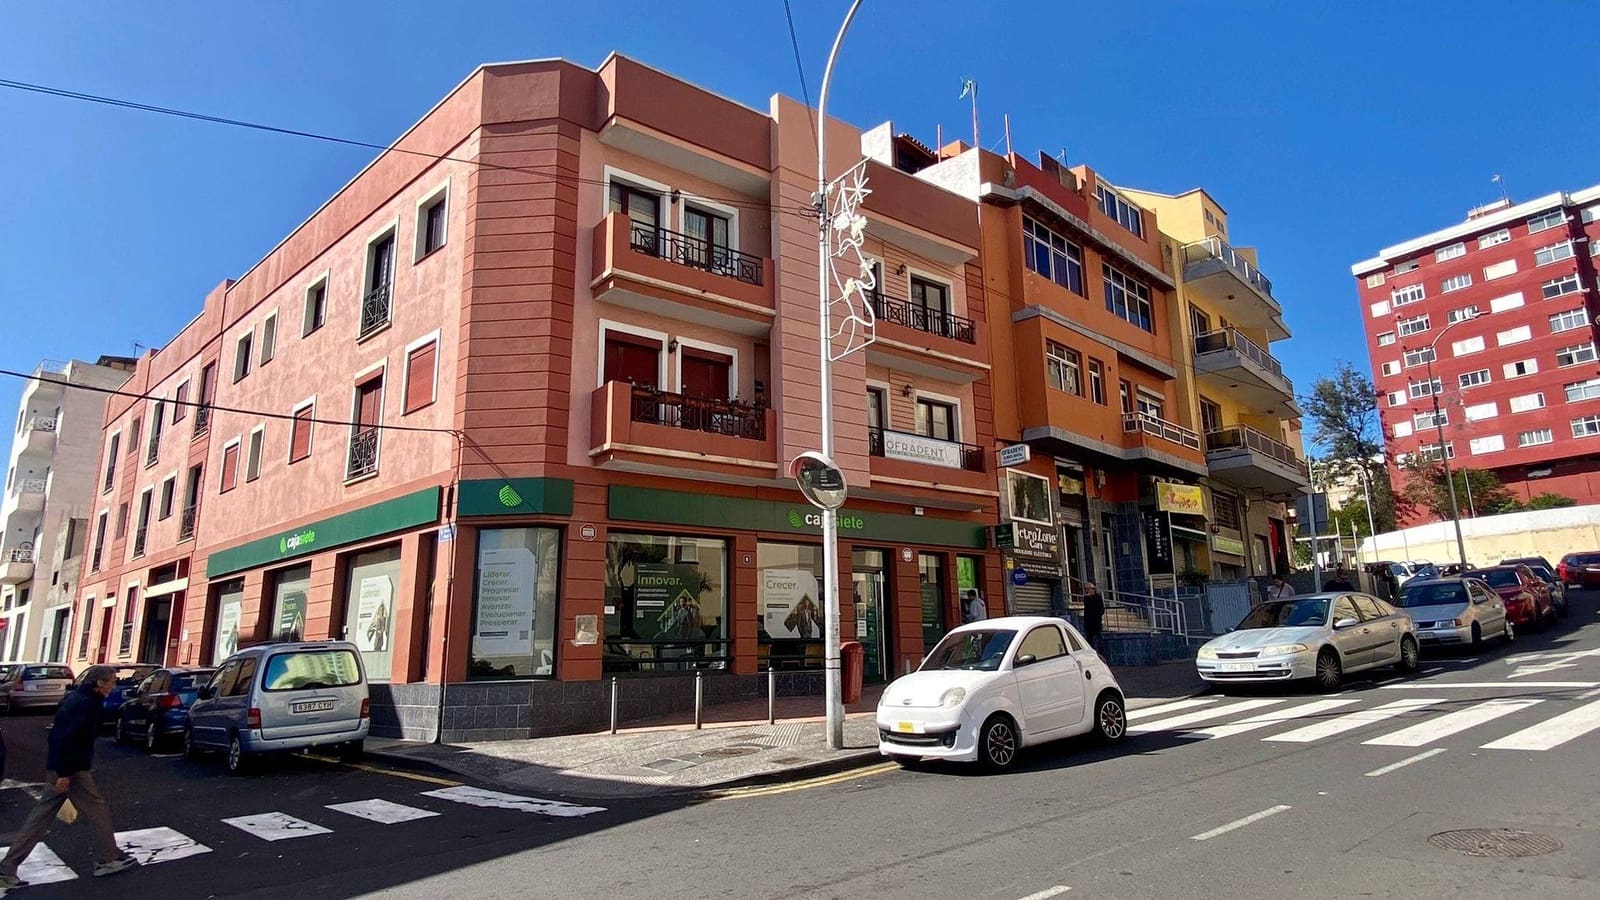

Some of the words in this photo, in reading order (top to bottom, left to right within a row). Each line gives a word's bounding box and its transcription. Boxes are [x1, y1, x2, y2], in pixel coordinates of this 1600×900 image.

[886, 440, 944, 458] OFRADENT
[805, 513, 864, 529] cajsiete
[287, 530, 315, 550] cajasiete
[637, 575, 683, 586] Innovar.
[766, 580, 799, 590] Crecer.
